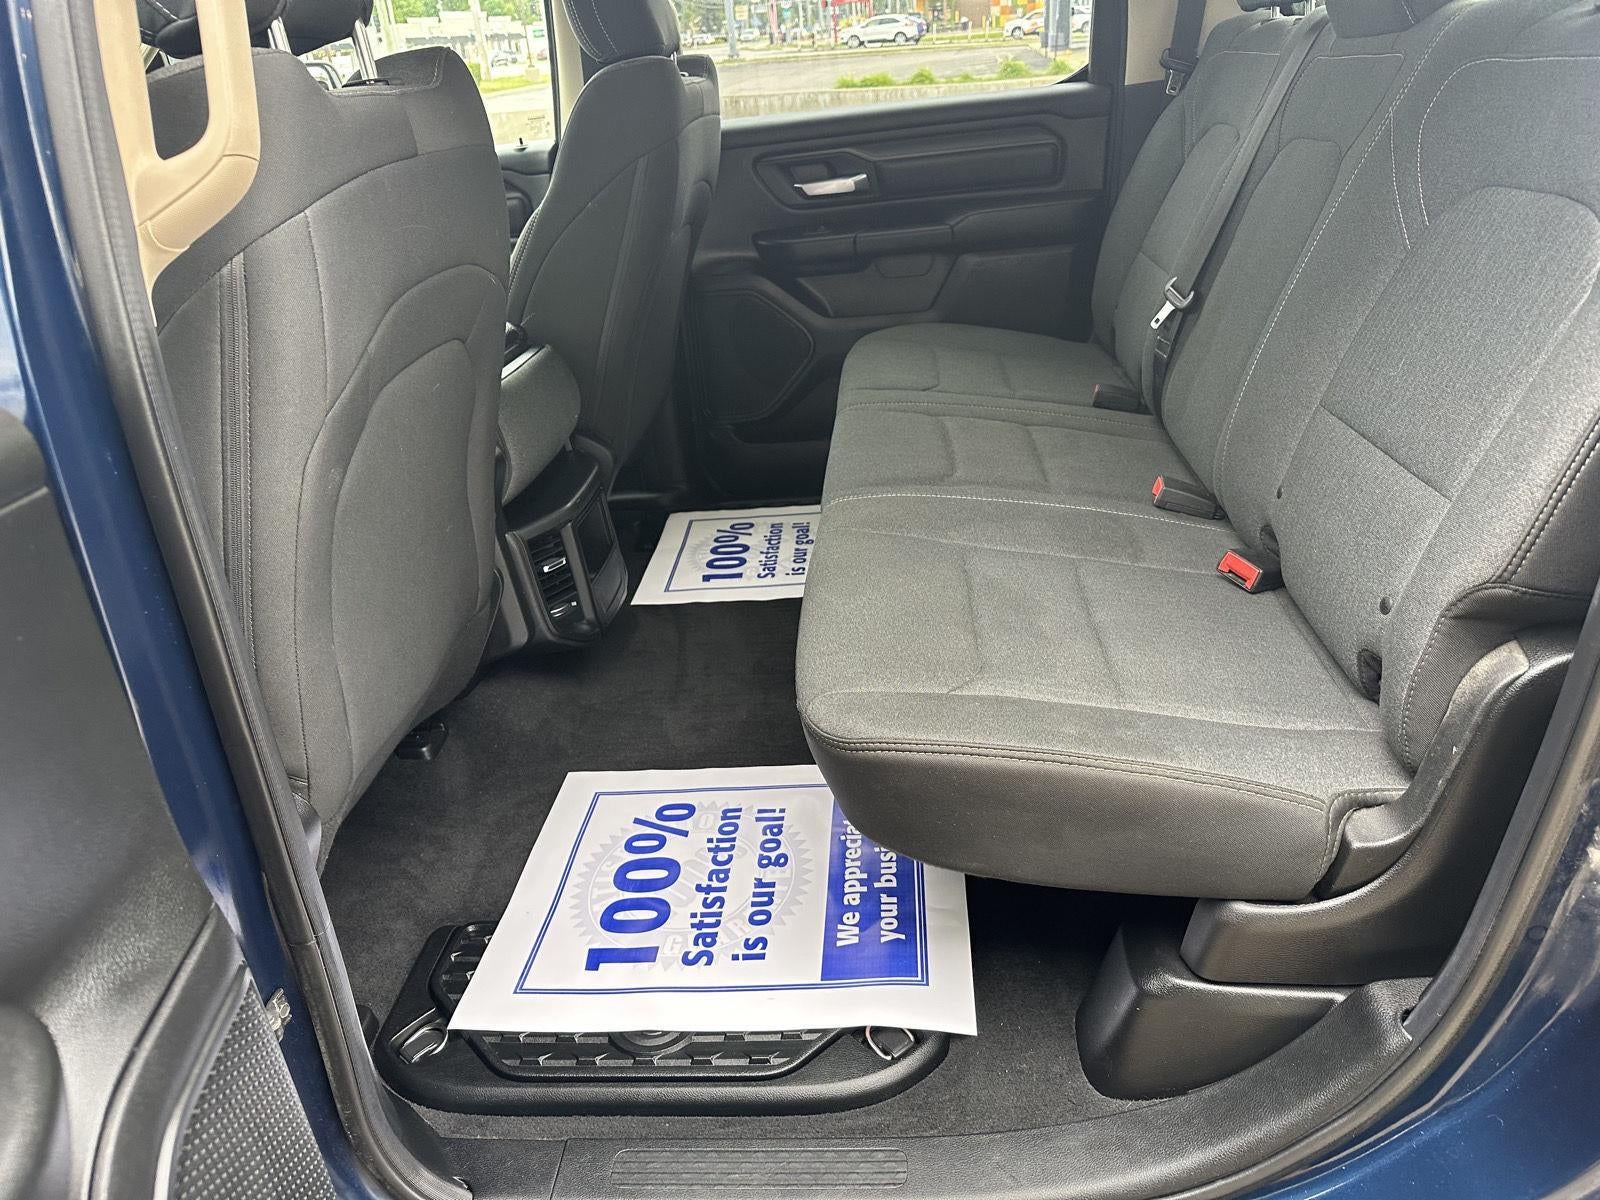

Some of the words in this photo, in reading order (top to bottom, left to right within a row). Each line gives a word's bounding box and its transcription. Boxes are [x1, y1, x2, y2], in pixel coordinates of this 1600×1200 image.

[702, 521, 755, 583] 100%
[757, 522, 784, 579] Satisfaction
[792, 521, 815, 545] goal!
[793, 546, 808, 564] our
[785, 566, 806, 576] is
[754, 807, 788, 869] goal!
[839, 819, 868, 906] apprecia
[584, 802, 697, 972] 100%
[681, 807, 743, 967] Satisfaction
[873, 846, 898, 888] busi
[748, 877, 777, 927] our
[880, 893, 906, 943] your
[732, 936, 768, 961] is
[836, 911, 861, 947] We
